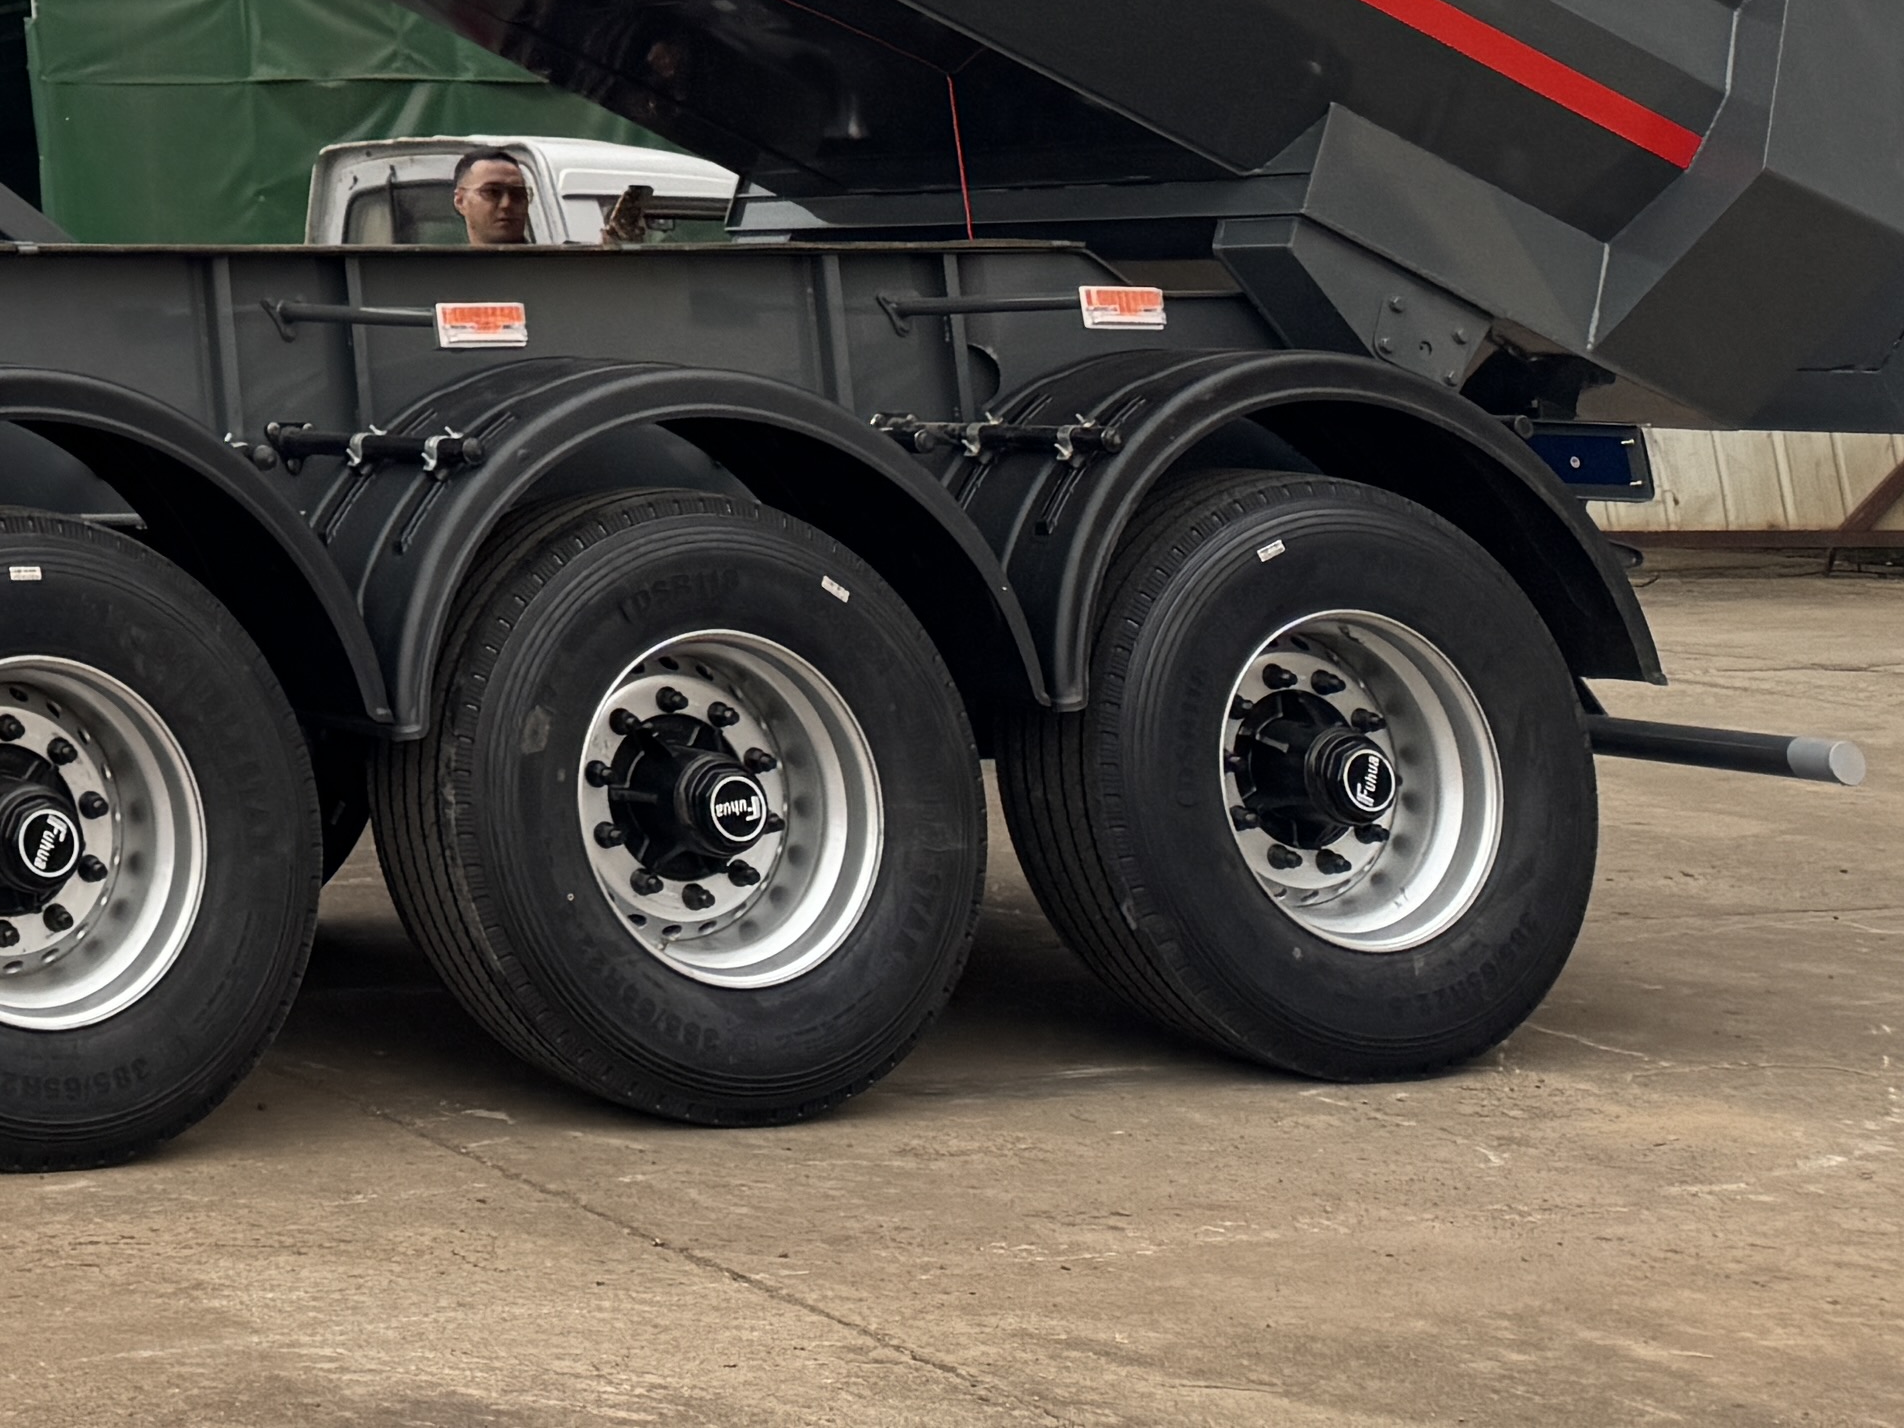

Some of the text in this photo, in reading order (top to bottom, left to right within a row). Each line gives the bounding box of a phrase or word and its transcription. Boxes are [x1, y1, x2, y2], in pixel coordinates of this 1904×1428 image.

[1356, 755, 1380, 807] Fuhua
[715, 795, 761, 821] Fuhua
[33, 813, 68, 870] Fuhua
